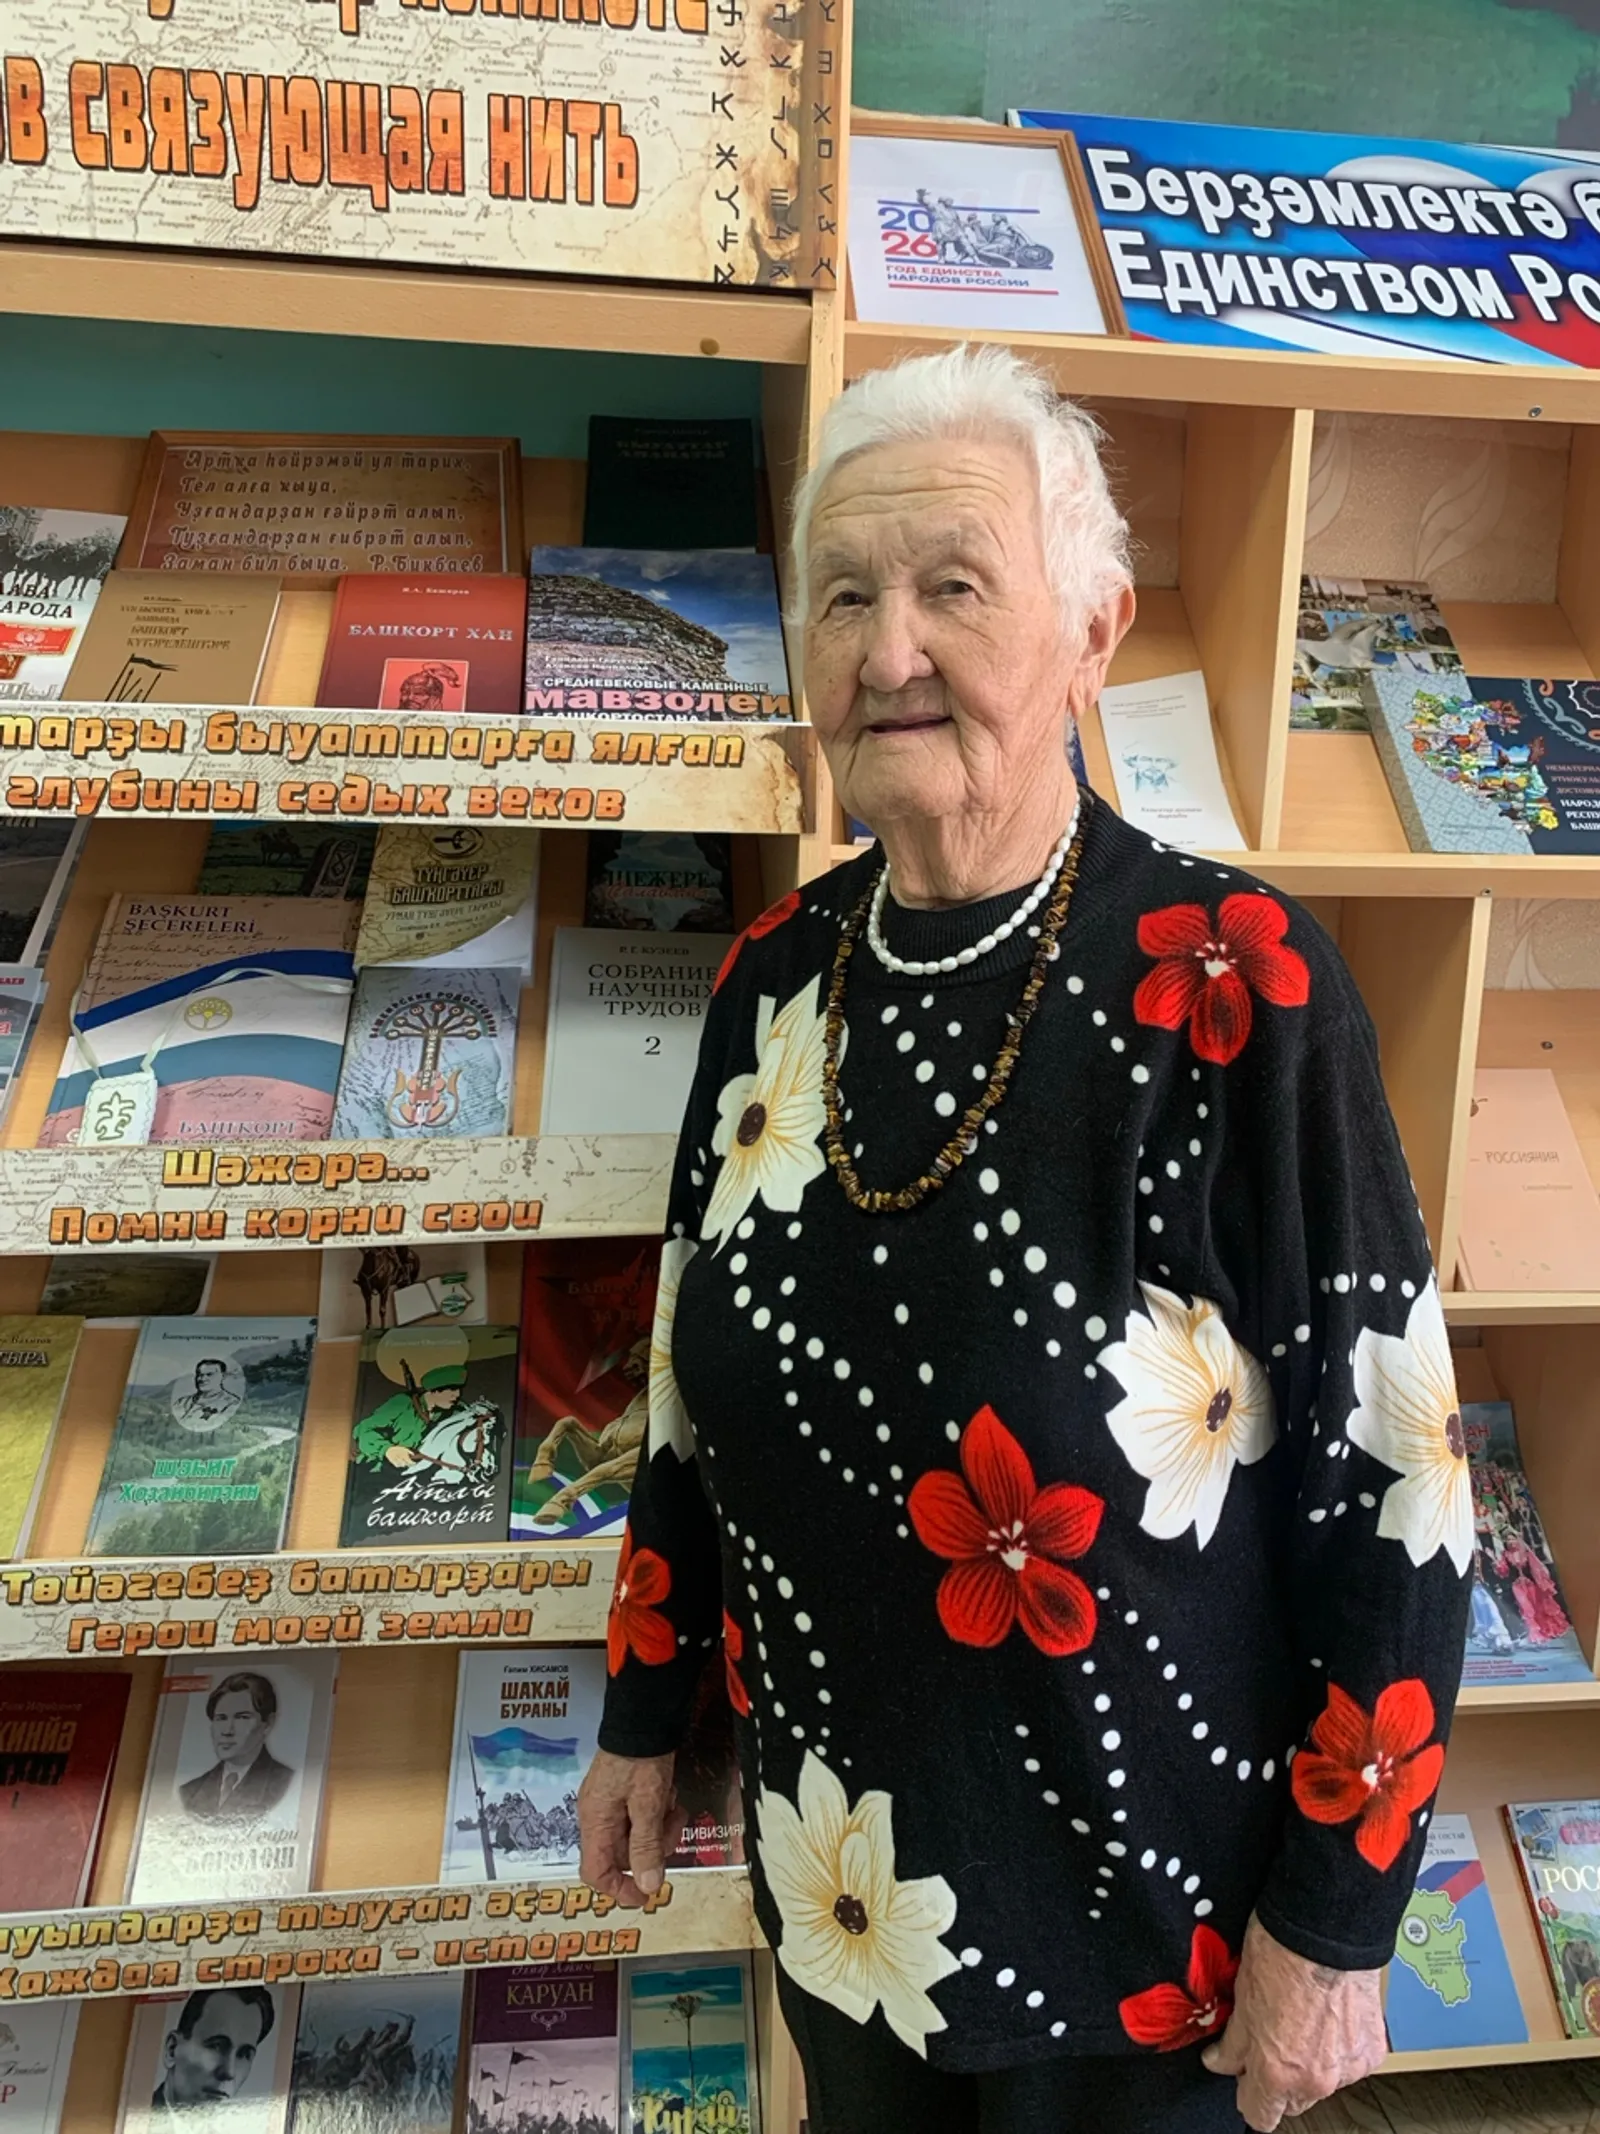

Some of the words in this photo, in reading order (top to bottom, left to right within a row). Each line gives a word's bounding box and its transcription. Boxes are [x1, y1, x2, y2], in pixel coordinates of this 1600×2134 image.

[1086, 148, 1568, 240] Берҙәмлектә
[878, 207, 935, 233] 20
[881, 232, 938, 258] 26
[886, 265, 917, 275] ГОД
[921, 267, 1003, 278] ЕДИНСТВА
[887, 274, 961, 284] НАРОДОВ
[965, 277, 1030, 287] РОССИИ
[1103, 229, 1515, 320] Единством
[371, 455, 393, 472] ул
[162, 553, 233, 571] Заман
[465, 628, 514, 641] ХАН
[544, 677, 677, 690] СРЕДНЕВЕКОВЫЕ
[681, 681, 769, 693] КАМЕННЫЕ
[205, 710, 574, 768] быуаттарға
[590, 731, 746, 769] ялғап
[6, 768, 260, 817] глубины
[277, 773, 451, 818] седых
[467, 784, 627, 821] веков
[129, 904, 233, 918] BAŞKURT
[588, 964, 719, 980] СОБРАНИЕ
[604, 1001, 702, 1018] ТРУДОВ
[644, 1036, 661, 1056] 2
[48, 1206, 227, 1245] Помни
[245, 1204, 405, 1244] корни
[422, 1199, 543, 1232] свои
[1, 1562, 273, 1604] Төйәгебеҙ
[289, 1558, 592, 1598] батырҙары
[67, 1617, 218, 1655] Герои
[233, 1605, 364, 1645] моей
[377, 1609, 533, 1641] земли
[500, 1702, 567, 1719] БУРАНЫ
[276, 1893, 471, 1932] тыуған
[196, 1945, 382, 1984] строка
[434, 1927, 641, 1966] история
